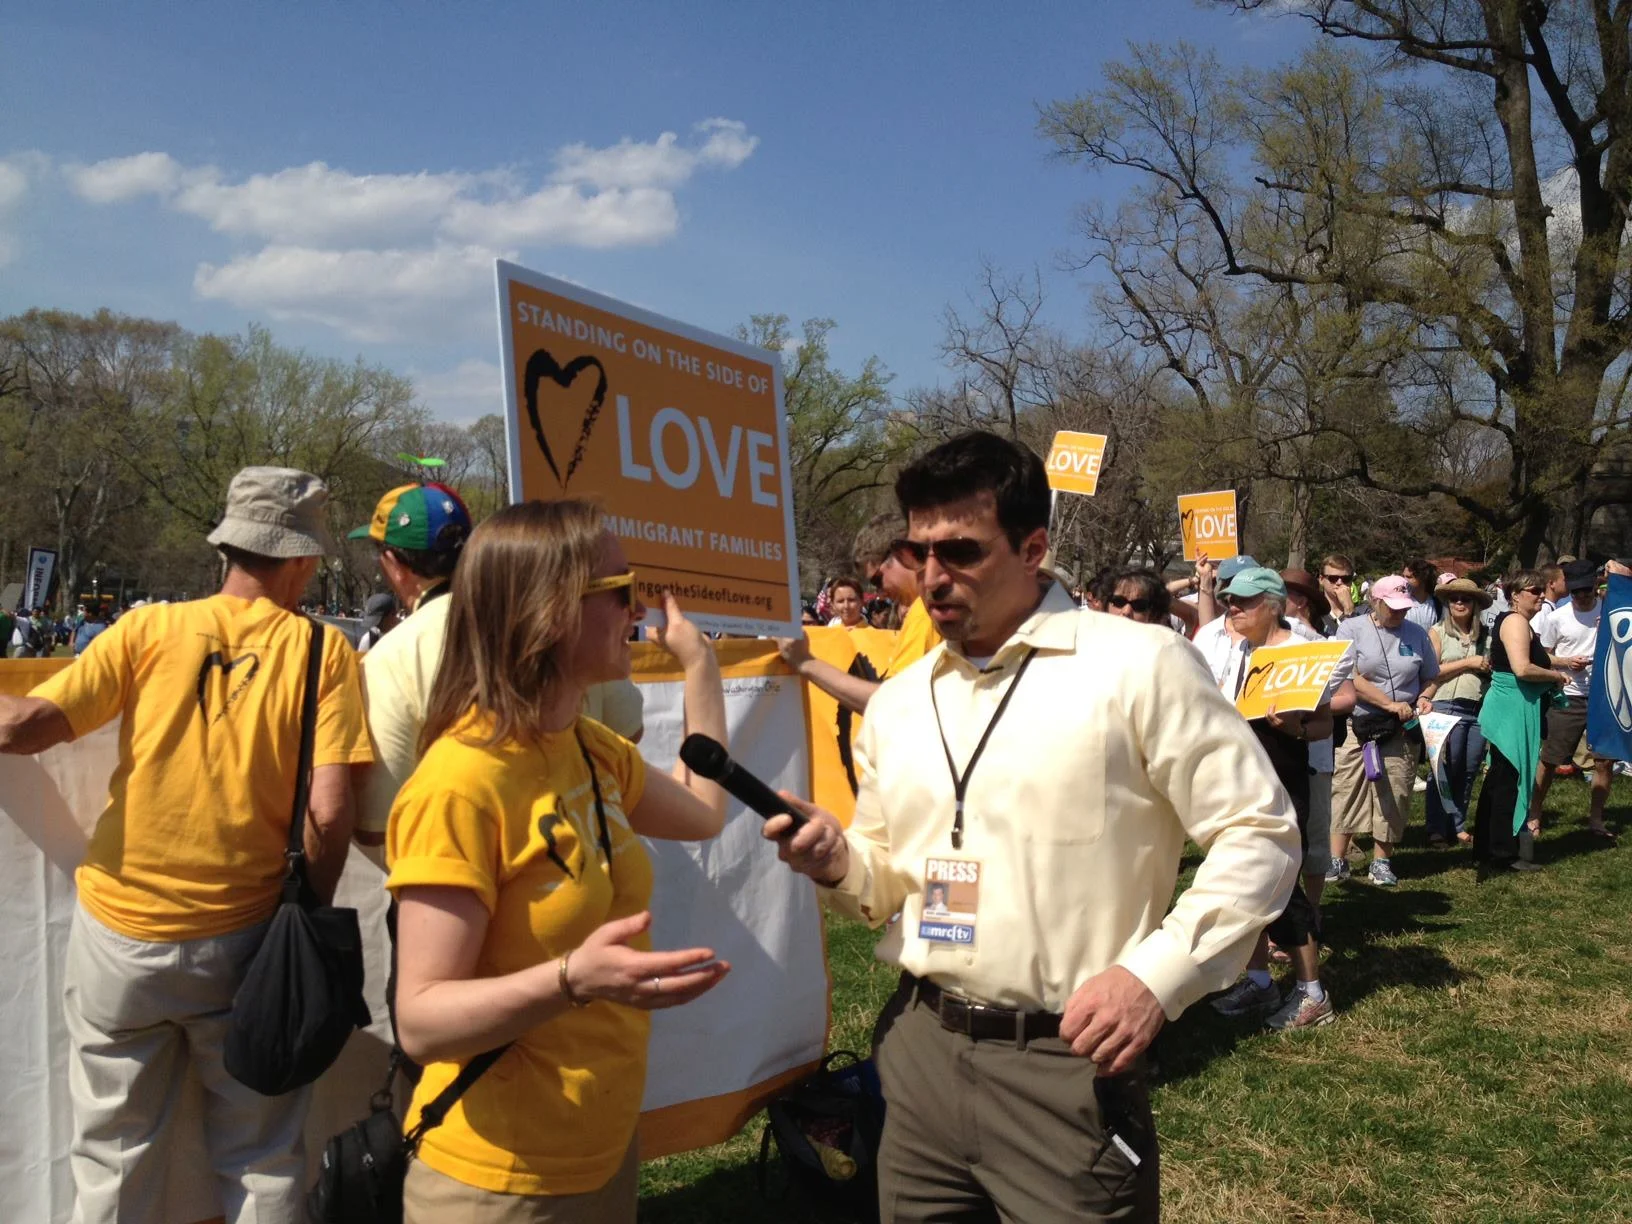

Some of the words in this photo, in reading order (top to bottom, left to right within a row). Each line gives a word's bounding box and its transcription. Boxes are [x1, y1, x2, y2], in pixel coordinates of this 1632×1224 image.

[517, 301, 627, 353] STANDING
[632, 338, 662, 364] ON
[666, 348, 701, 376] THE
[706, 361, 743, 389] SIDE
[748, 375, 769, 395] OF
[615, 394, 779, 508] LOVE
[1049, 450, 1098, 475] LOVE
[602, 515, 704, 549] MMIGRANT
[710, 532, 782, 561] FAMILIES
[1194, 513, 1236, 539] LOVE
[1265, 662, 1333, 689] LOVE
[927, 860, 977, 882] PRESS
